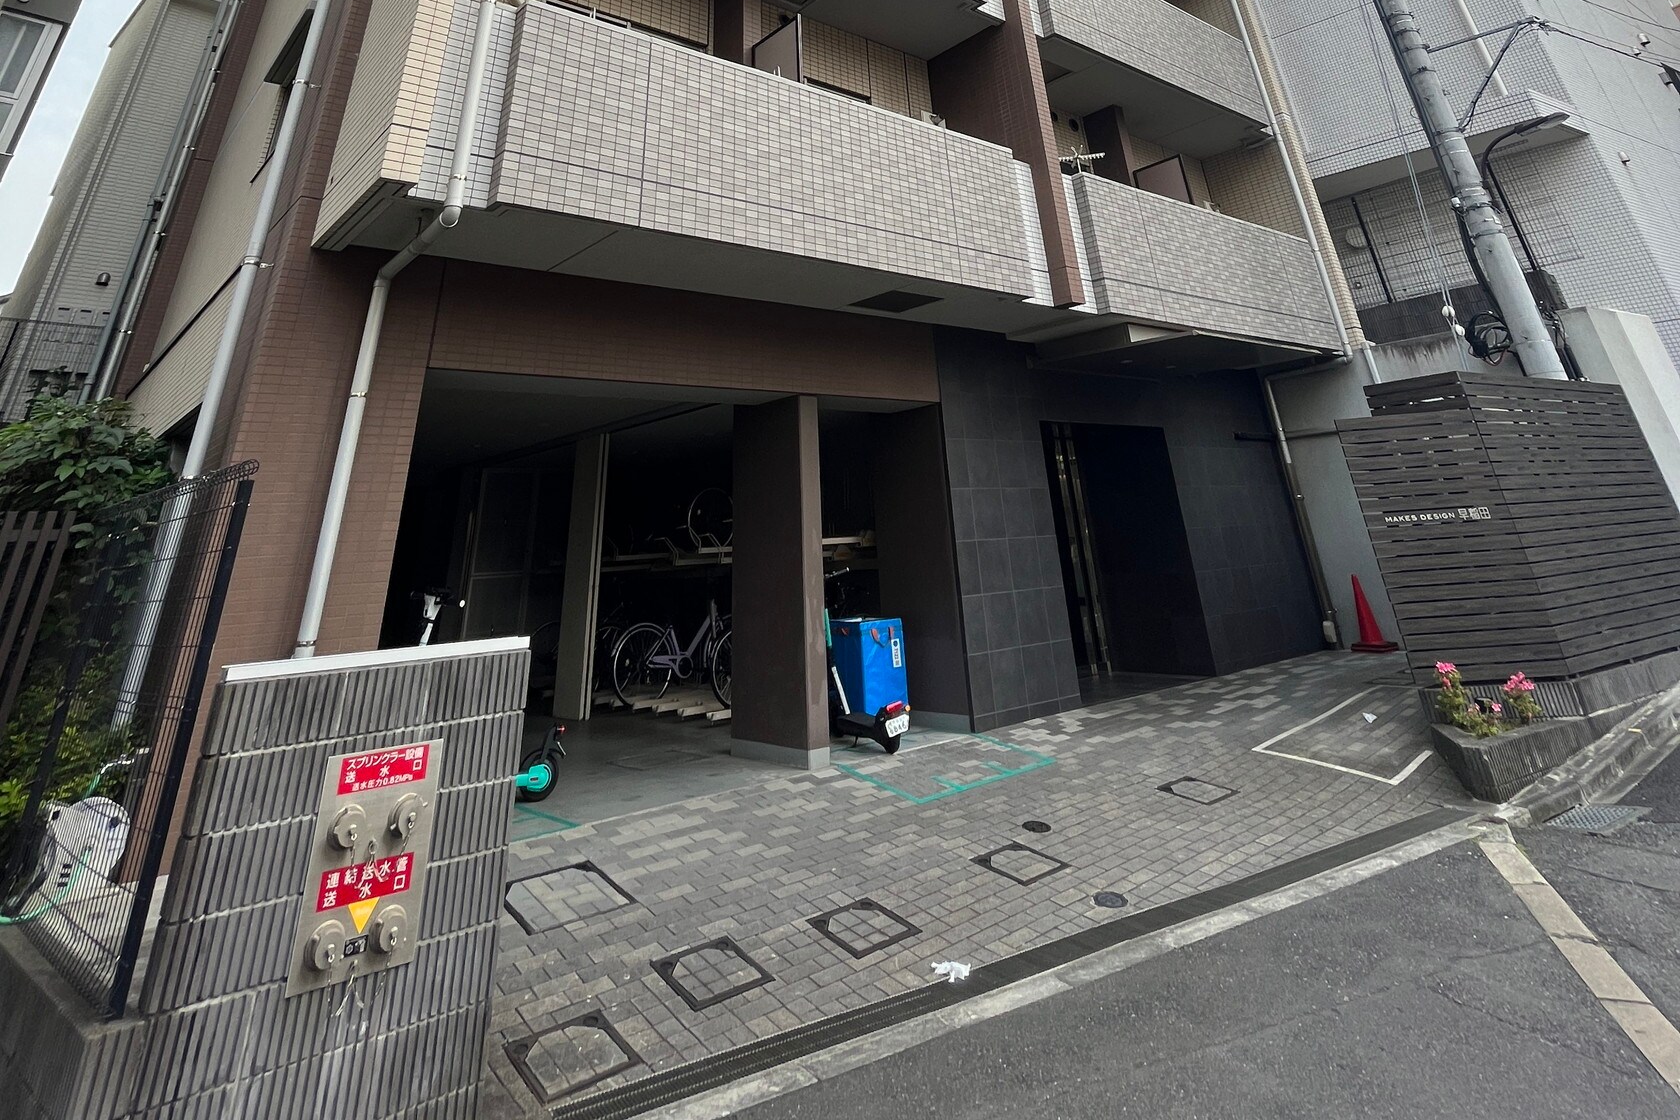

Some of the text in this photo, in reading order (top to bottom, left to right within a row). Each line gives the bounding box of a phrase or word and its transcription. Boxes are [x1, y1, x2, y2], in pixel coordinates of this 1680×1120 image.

[1385, 506, 1492, 523] MAKES DESIGN 早稲田
[346, 747, 425, 771] スプリンクラー設備
